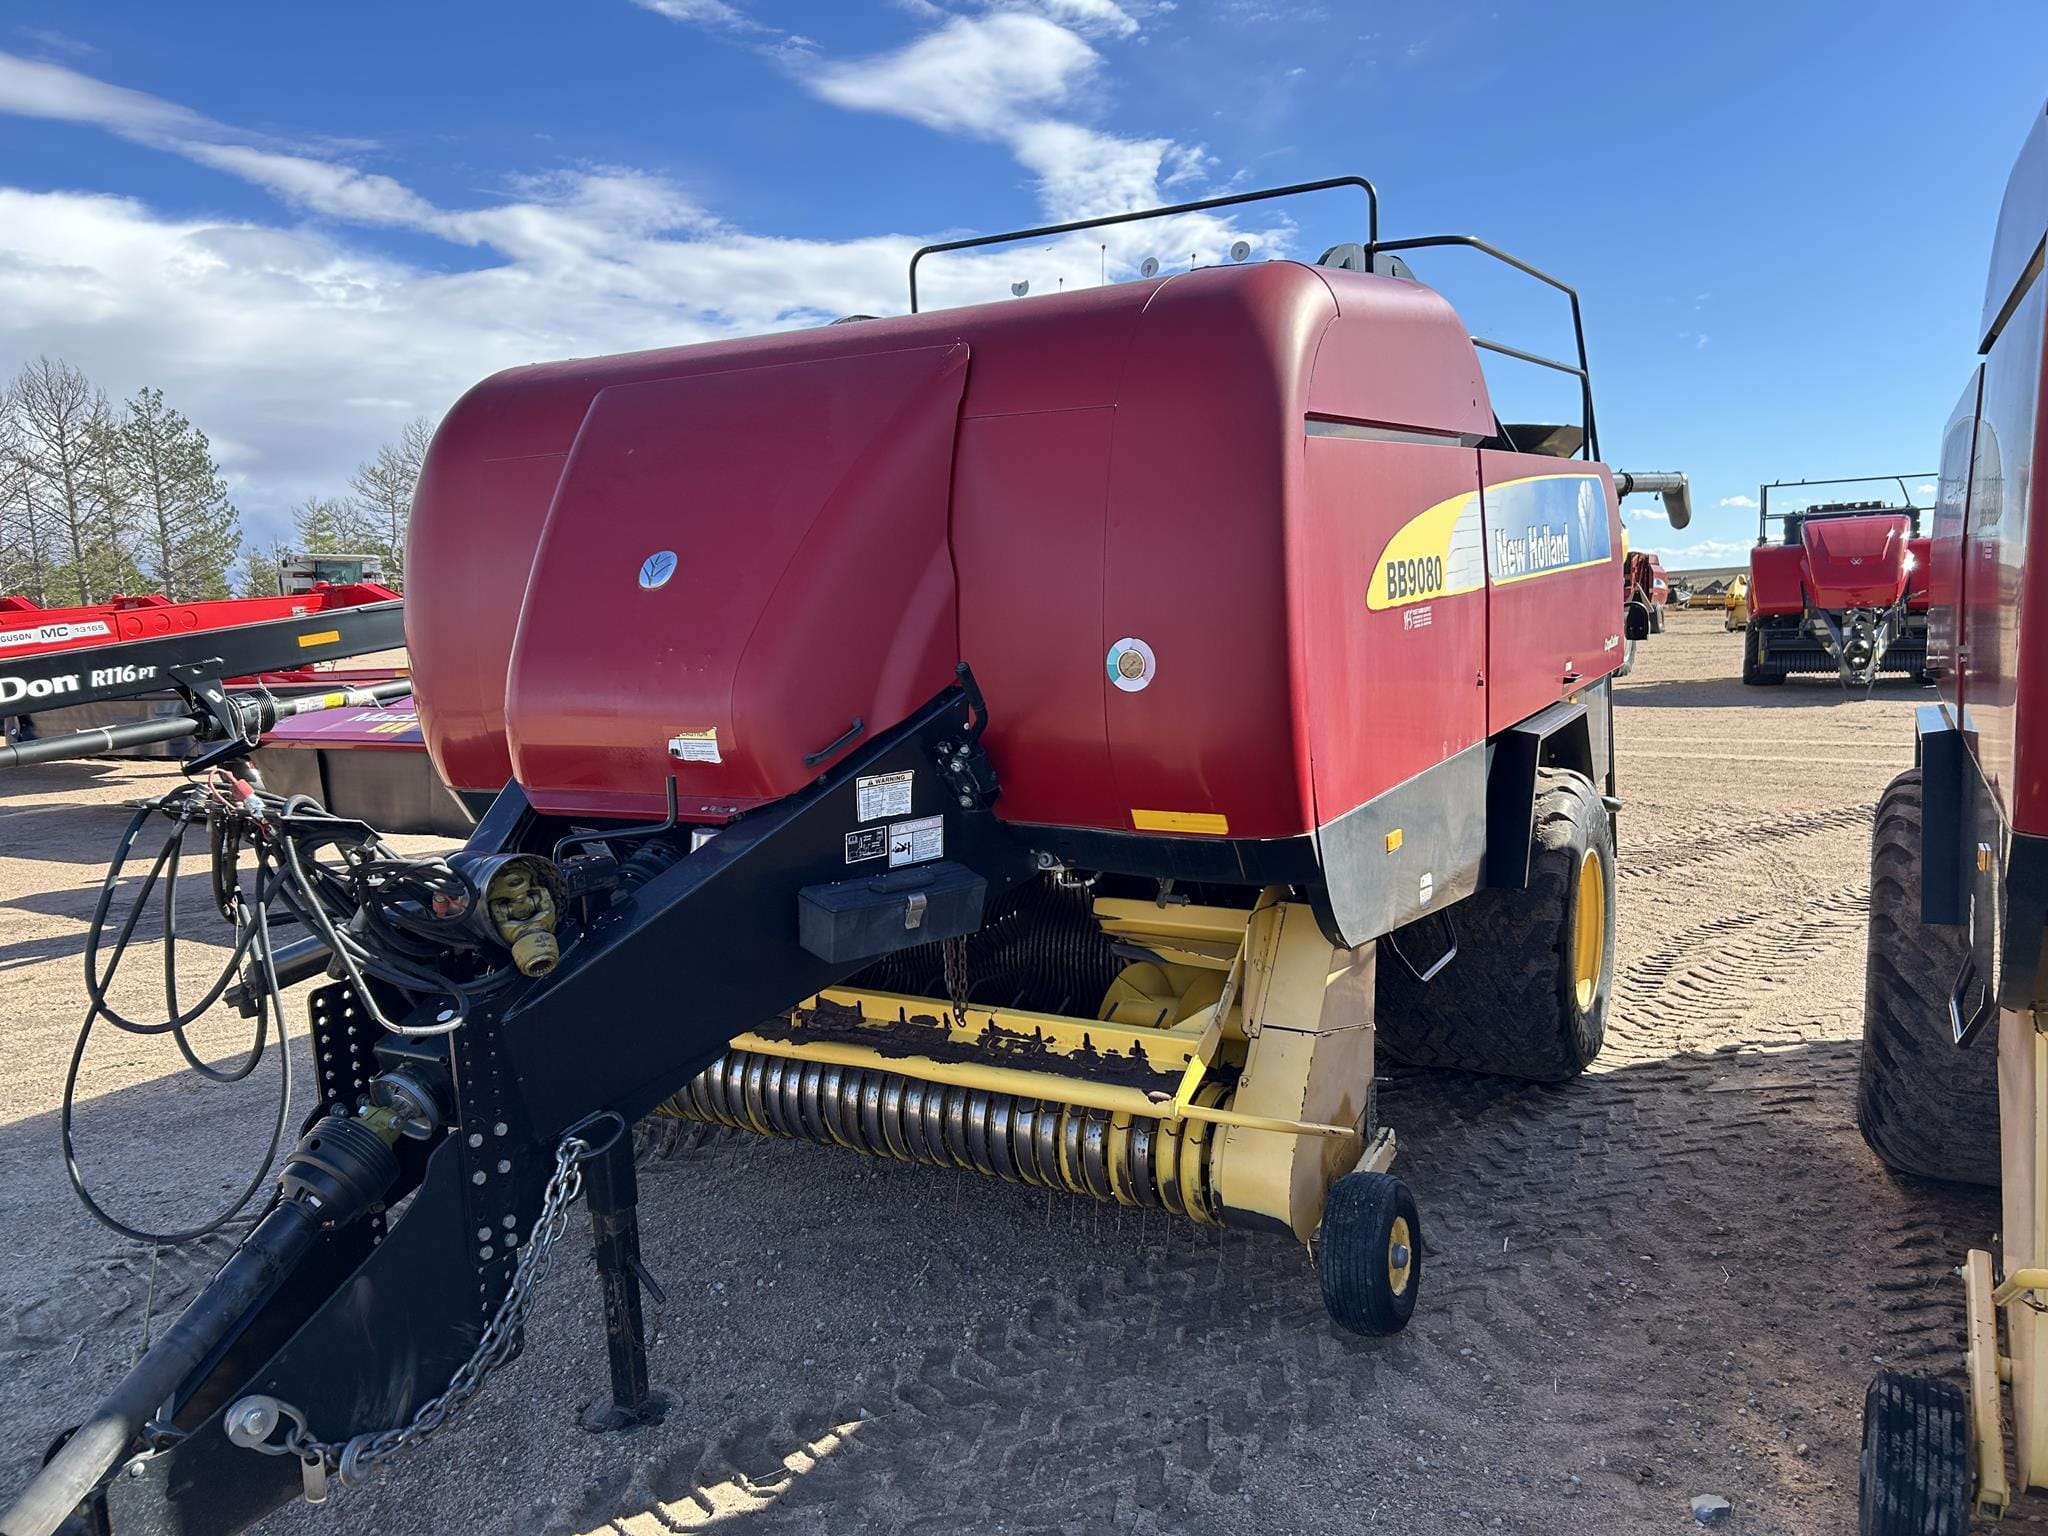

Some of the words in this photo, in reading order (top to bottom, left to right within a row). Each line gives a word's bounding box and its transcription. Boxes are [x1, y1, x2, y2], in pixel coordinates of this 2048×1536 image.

[1494, 528, 1526, 576] New
[1527, 523, 1570, 570] Holland
[1387, 555, 1443, 600] BB9080
[0, 633, 32, 643] GUSON
[40, 626, 69, 639] MC
[0, 674, 80, 702] Don
[91, 664, 137, 688] R116
[138, 665, 158, 680] PT
[875, 774, 906, 785] WARNING
